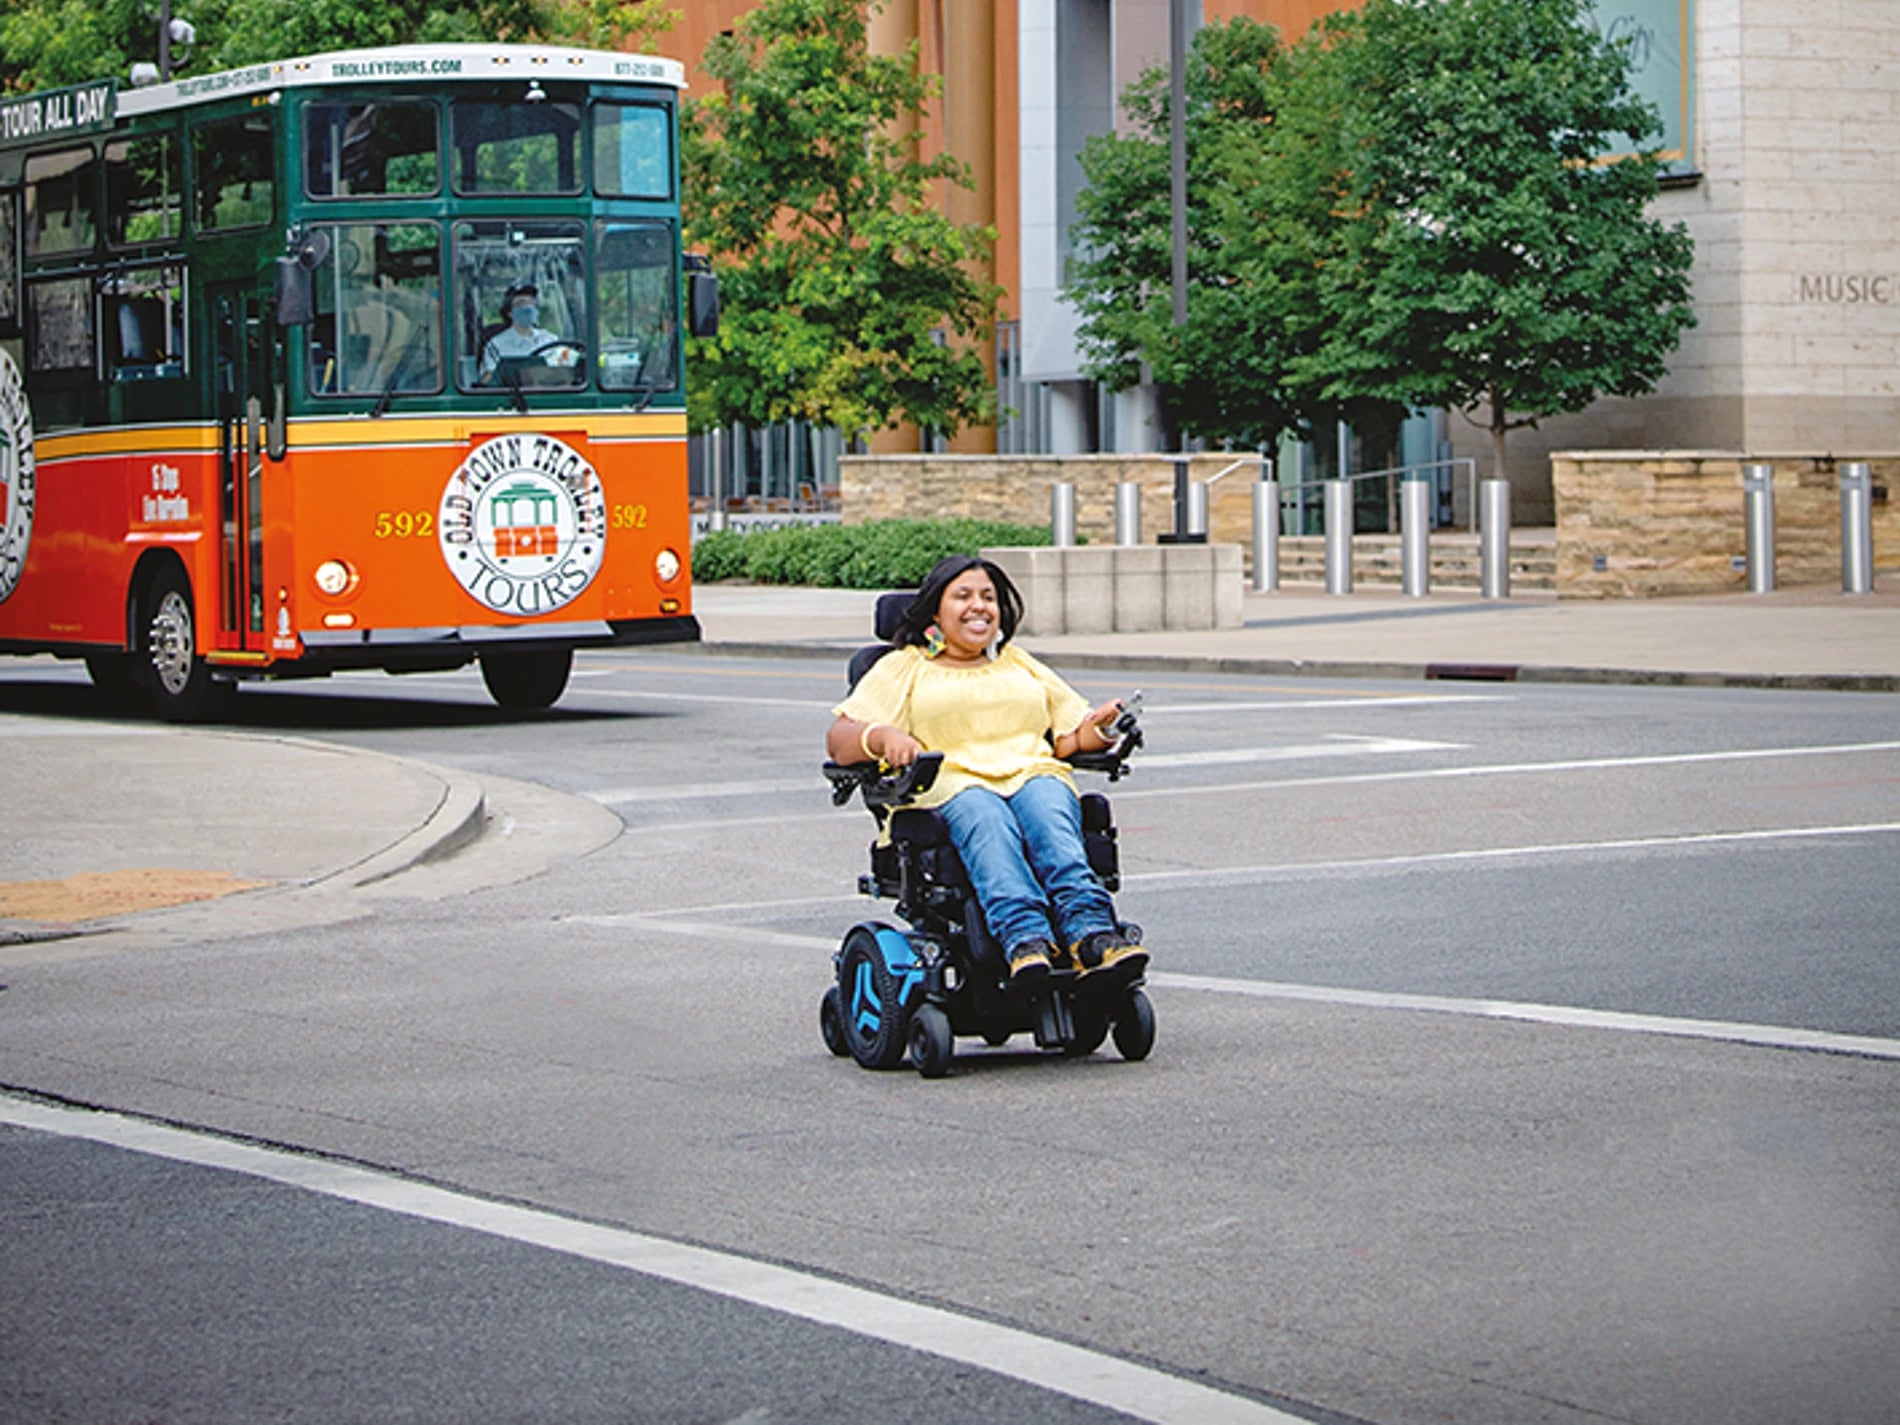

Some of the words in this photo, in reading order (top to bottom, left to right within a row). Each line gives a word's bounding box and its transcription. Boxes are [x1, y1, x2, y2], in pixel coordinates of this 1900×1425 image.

[331, 59, 463, 77] TROLLEYTOURS.COM
[2, 100, 42, 139] TOUR
[45, 94, 73, 131] ALL
[77, 87, 108, 125] DAY
[1800, 274, 1889, 303] MUSIC
[458, 437, 523, 492] TOWN
[374, 511, 433, 538] 592
[444, 494, 473, 544] OLD
[612, 505, 648, 529] 592
[469, 558, 589, 614] TOURS
